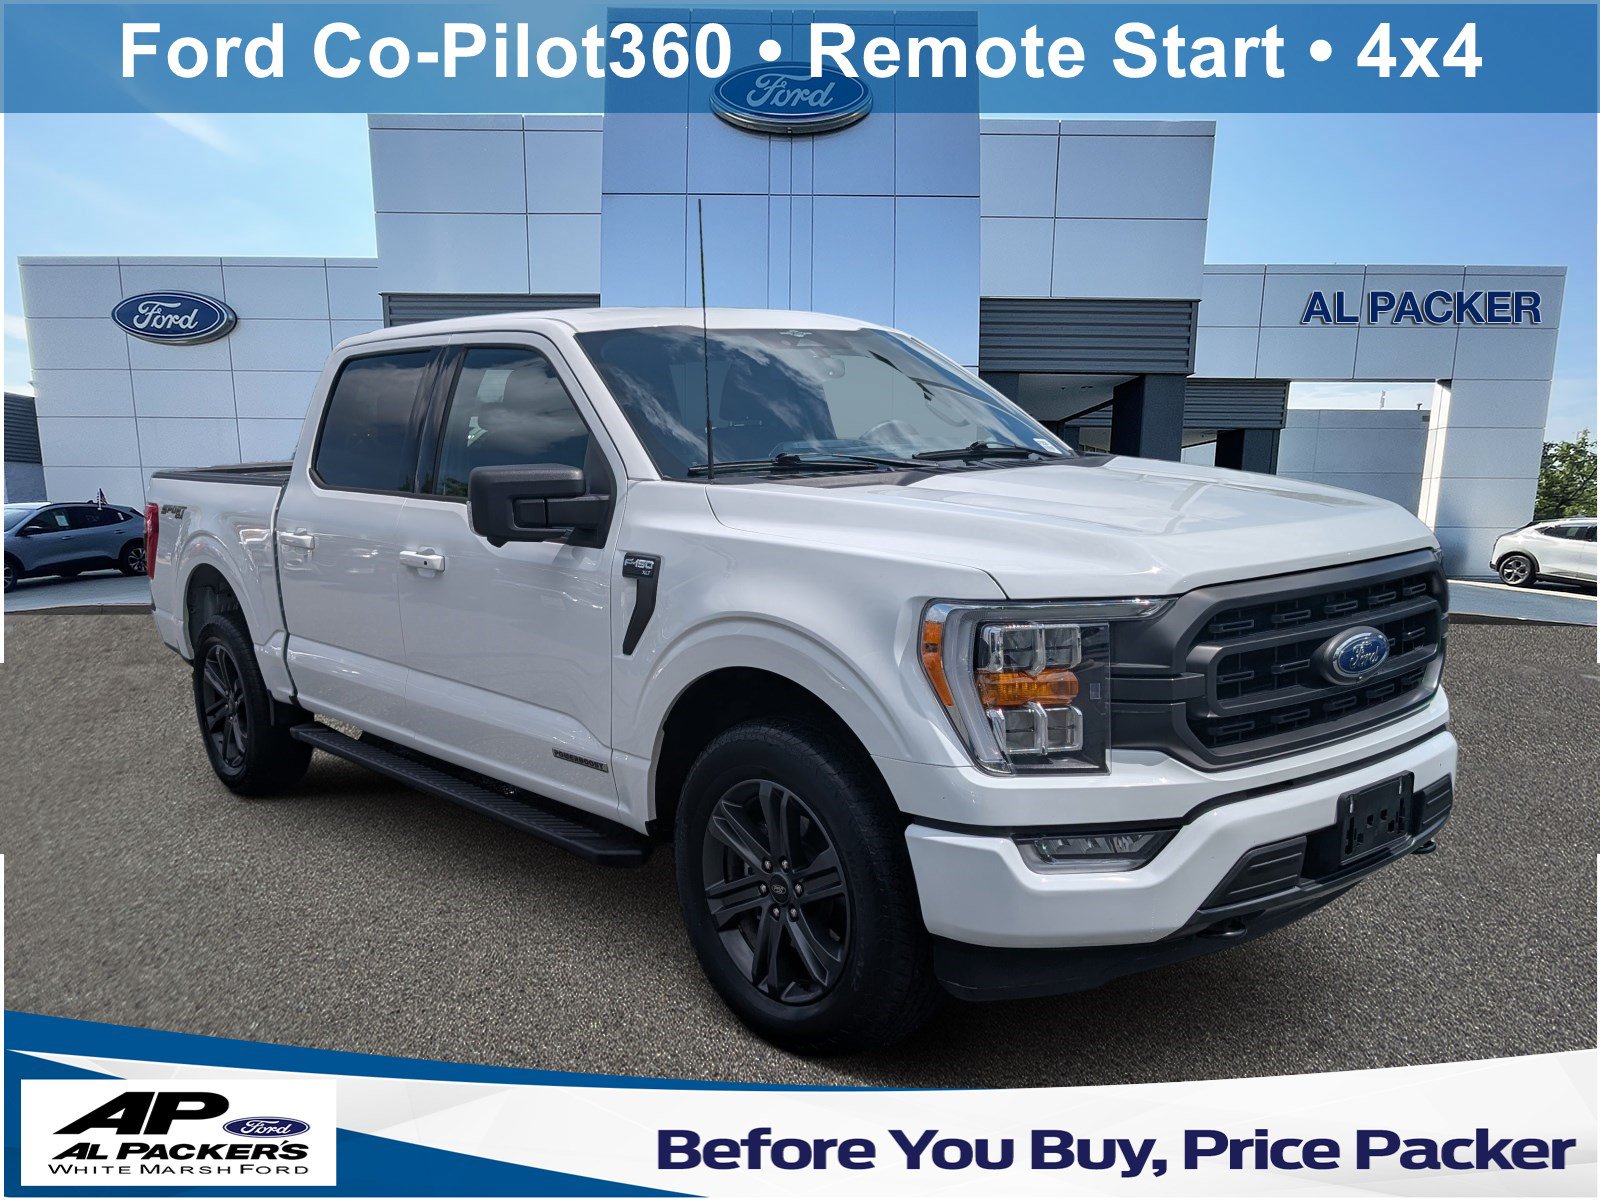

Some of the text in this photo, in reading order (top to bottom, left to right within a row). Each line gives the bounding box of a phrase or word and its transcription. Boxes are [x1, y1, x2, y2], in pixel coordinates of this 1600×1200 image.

[746, 73, 836, 108] Ford
[133, 301, 199, 329] Ford
[1301, 289, 1542, 325] AL PACKER
[624, 558, 654, 569] F-150
[1350, 641, 1379, 669] Ford
